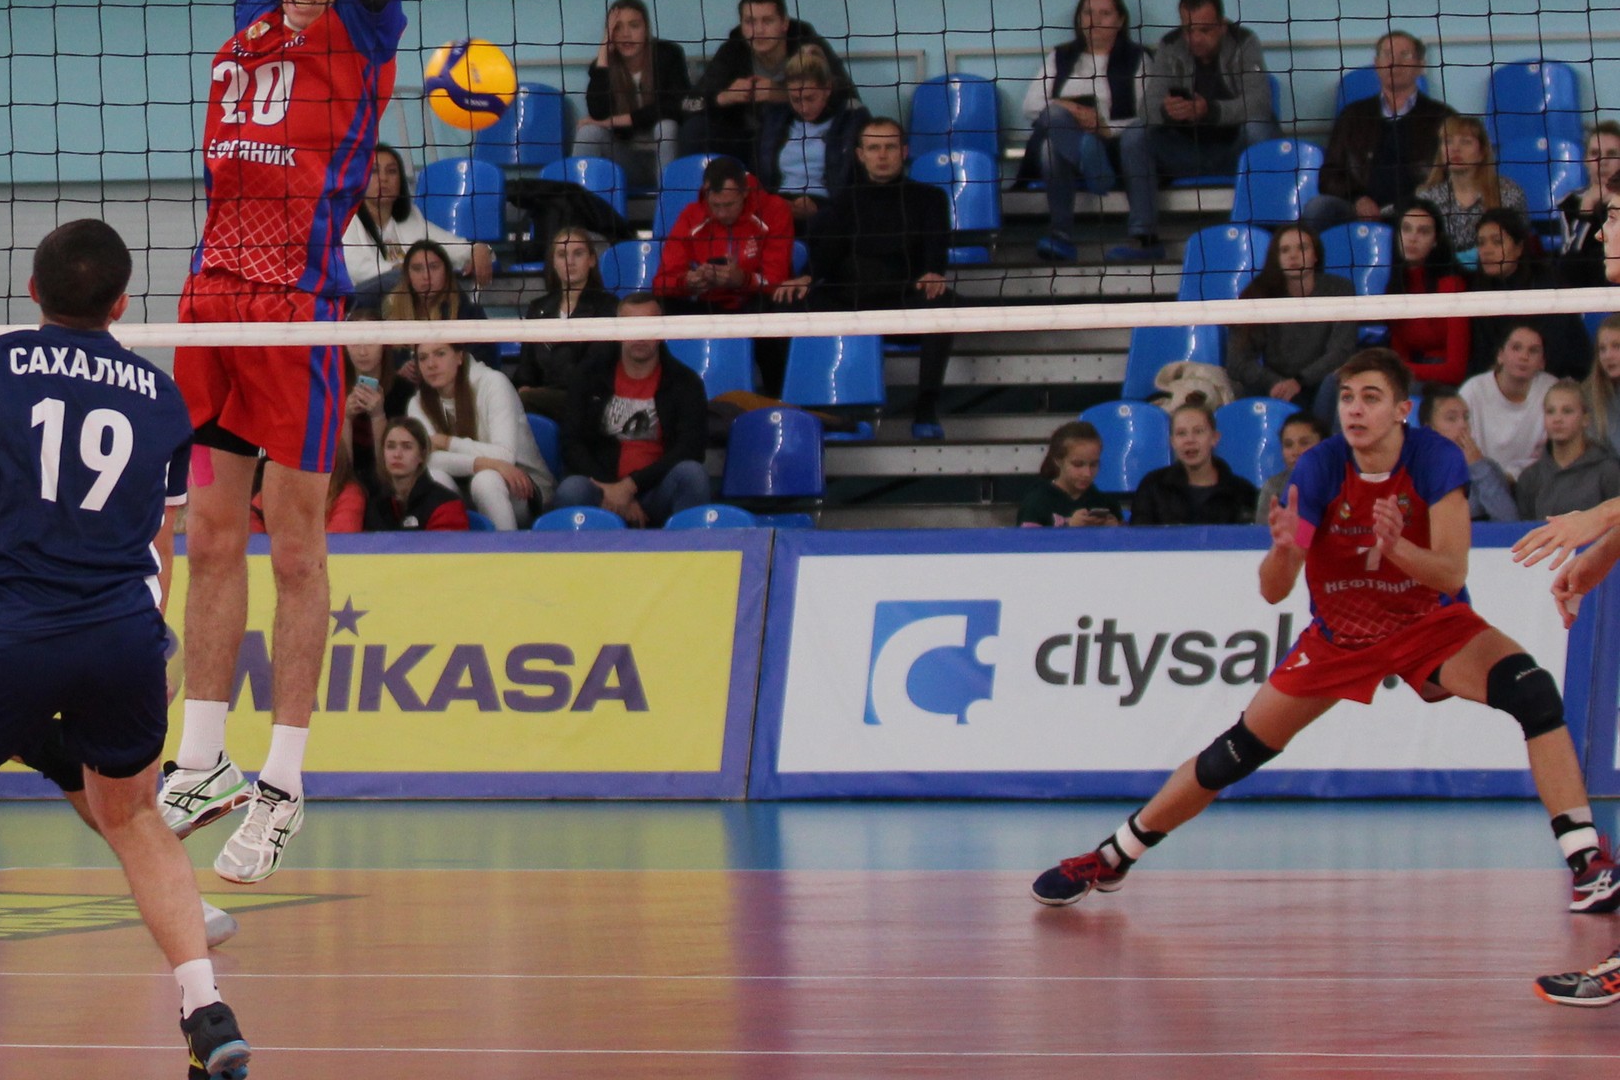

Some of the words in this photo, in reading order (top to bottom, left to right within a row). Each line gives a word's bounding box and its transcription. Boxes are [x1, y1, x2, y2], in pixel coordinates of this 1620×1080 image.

[212, 60, 296, 126] 20
[9, 346, 157, 400] САХАЛИН
[31, 397, 134, 512] 19
